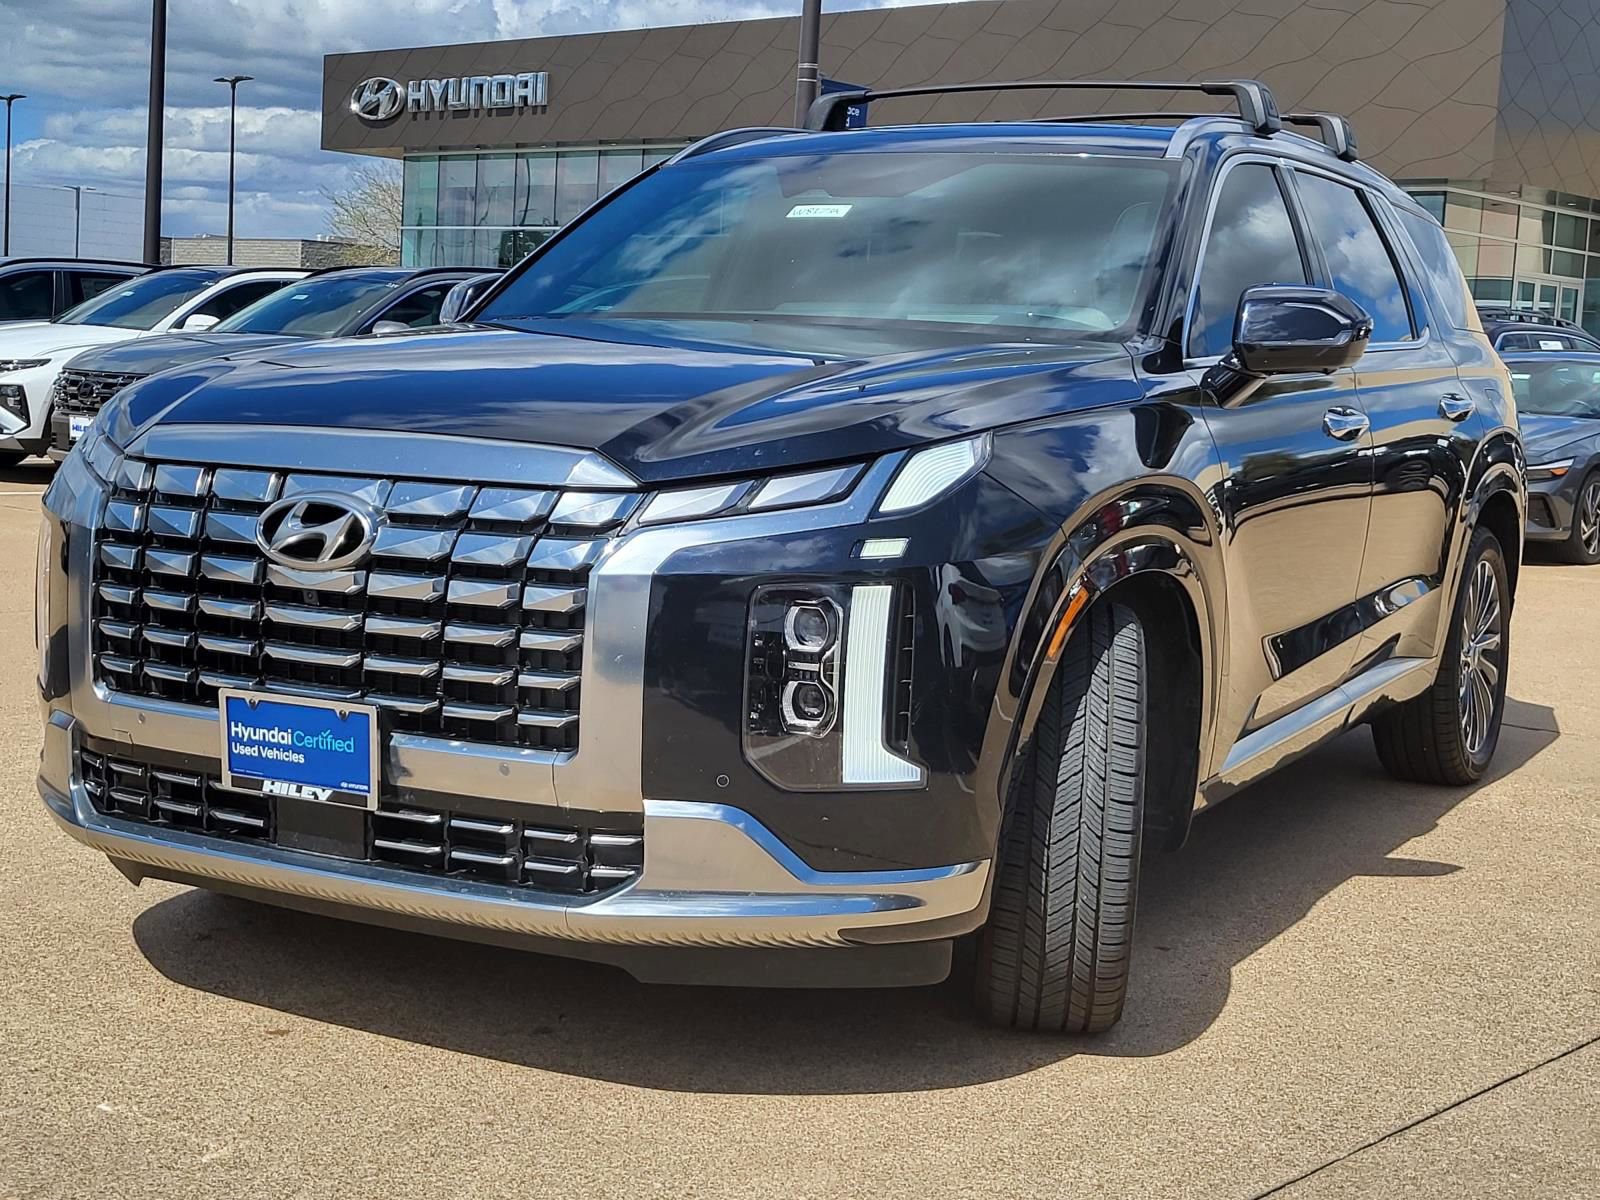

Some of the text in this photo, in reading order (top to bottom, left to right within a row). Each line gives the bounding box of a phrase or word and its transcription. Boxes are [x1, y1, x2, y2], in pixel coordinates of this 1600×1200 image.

[407, 72, 549, 112] HYUNDAI
[231, 721, 354, 753] Hyundai Certified
[232, 742, 305, 763] Used Vehicles
[262, 780, 333, 801] HILEY
